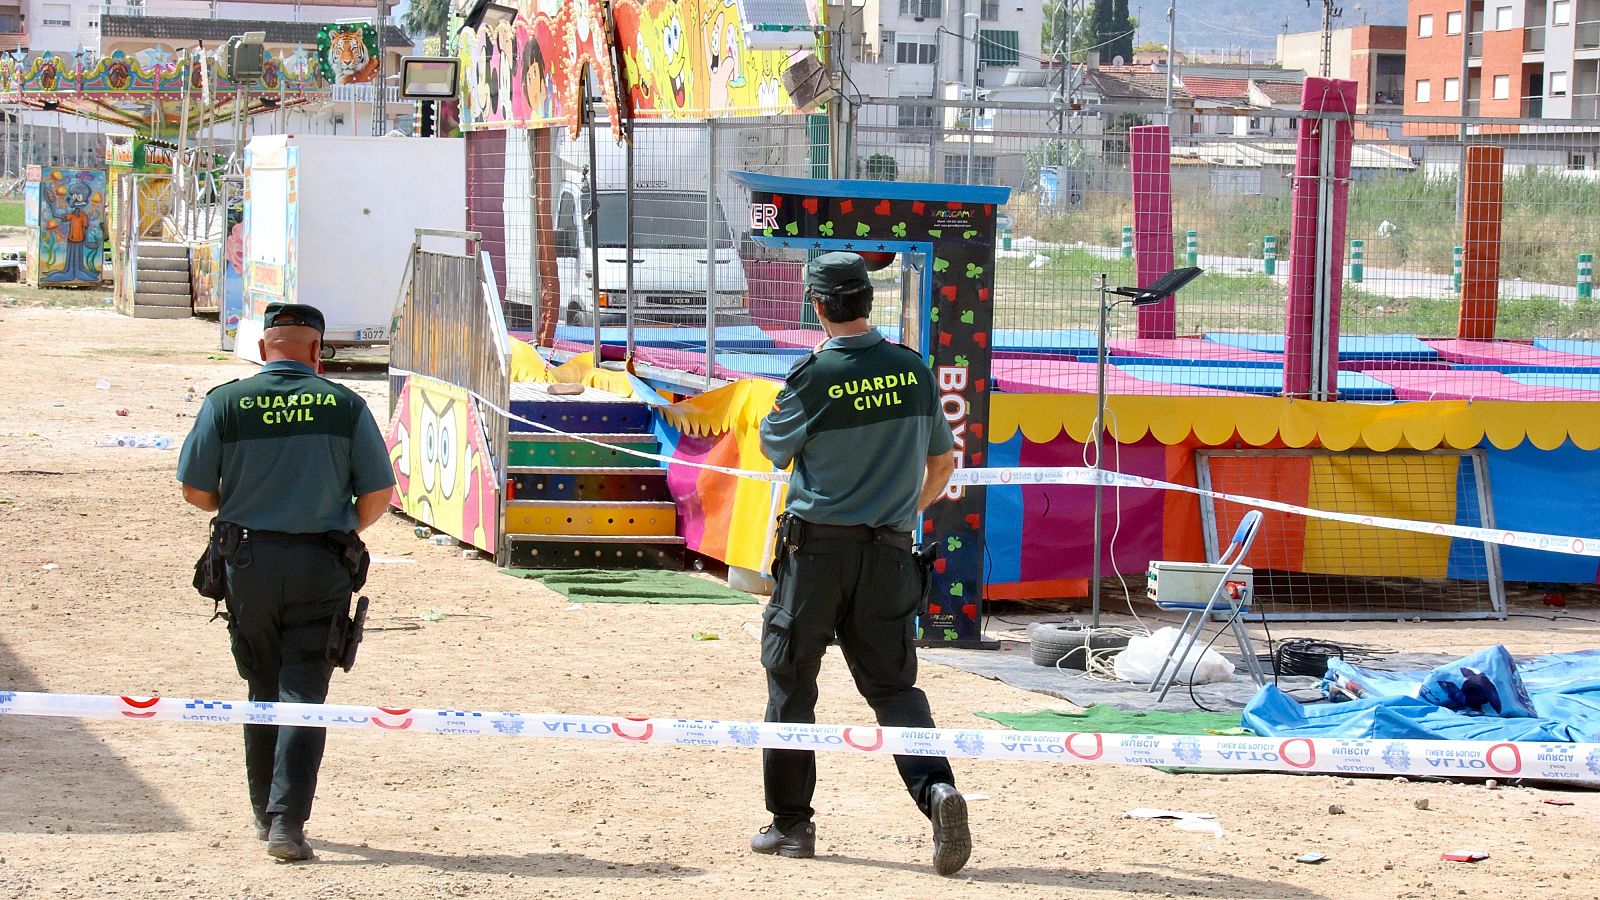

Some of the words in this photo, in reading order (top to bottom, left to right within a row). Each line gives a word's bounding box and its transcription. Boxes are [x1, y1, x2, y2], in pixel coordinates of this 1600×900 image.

[750, 203, 780, 230] ER
[362, 330, 384, 339] 3077
[828, 371, 919, 399] GUARDIA
[239, 393, 337, 410] GUARDIA
[853, 391, 902, 411] CIVIL
[262, 408, 314, 425] CIVIL
